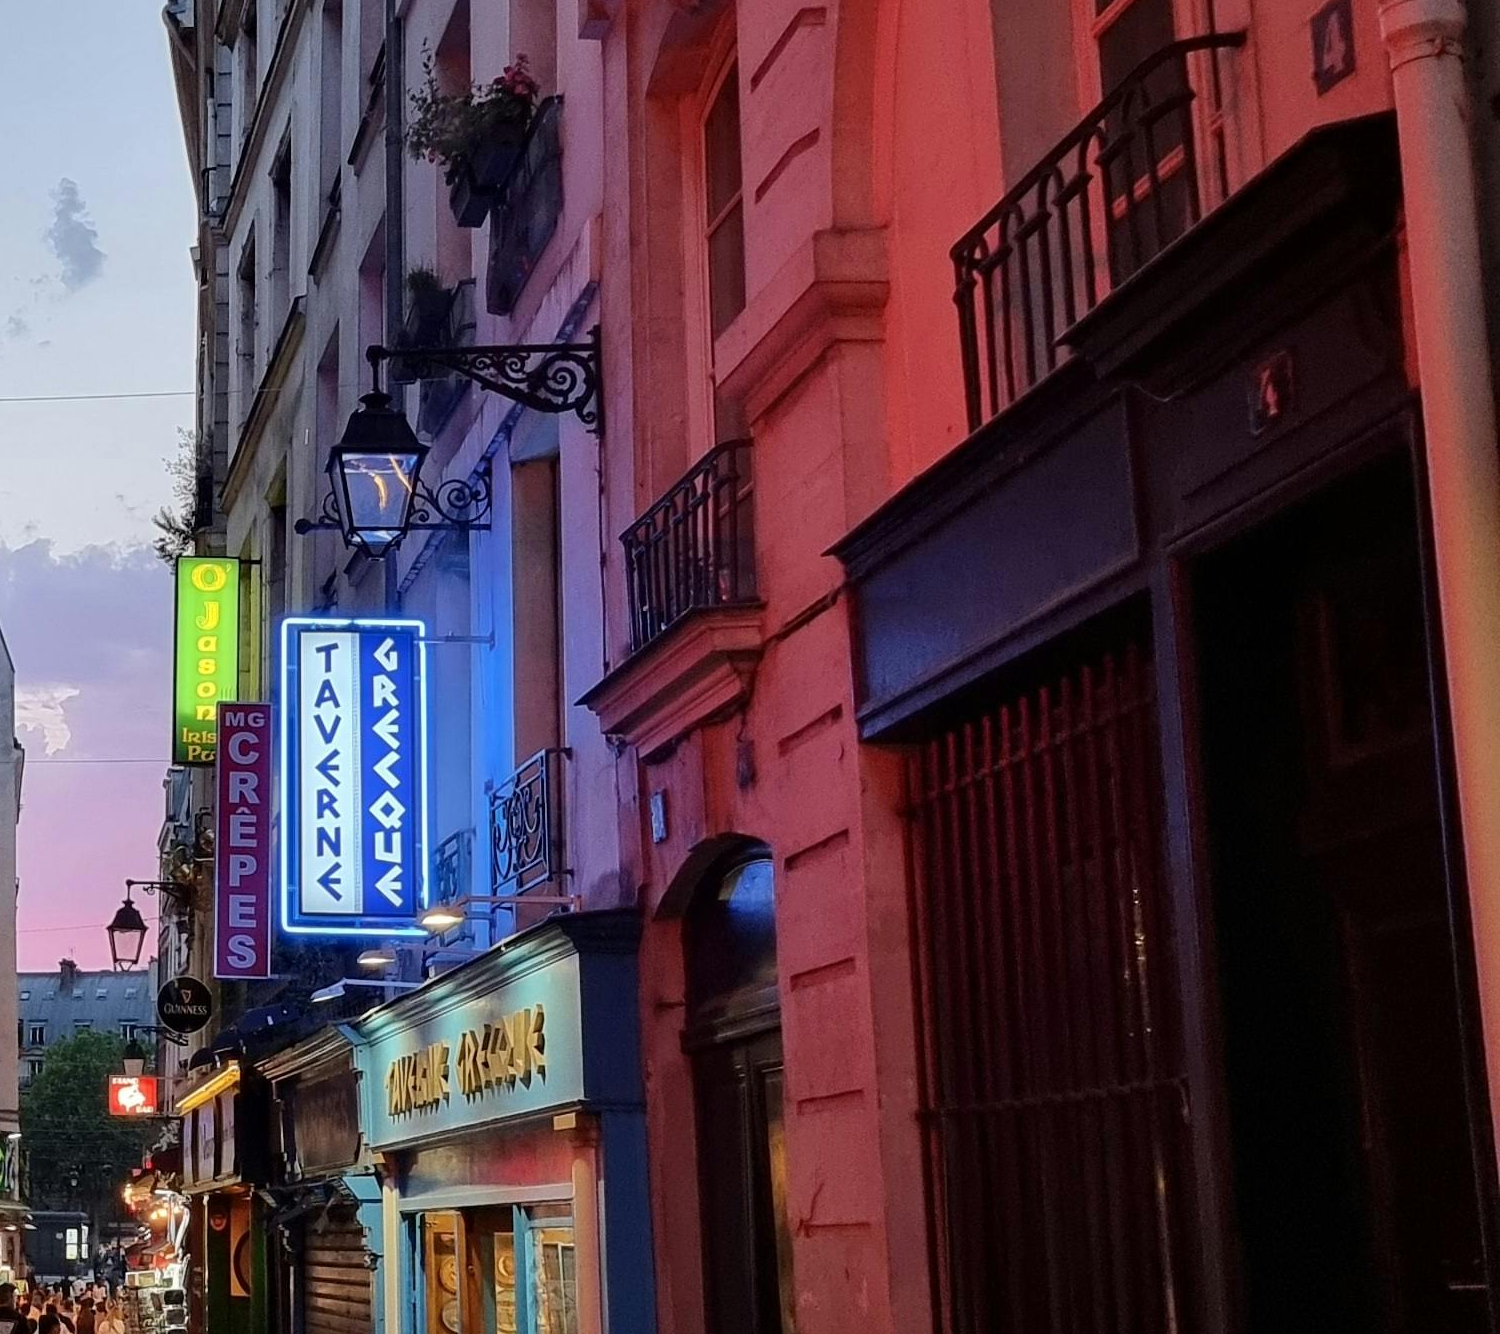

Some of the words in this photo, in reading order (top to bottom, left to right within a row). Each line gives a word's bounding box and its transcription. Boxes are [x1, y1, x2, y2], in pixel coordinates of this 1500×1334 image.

[1322, 10, 1347, 75] 4
[225, 711, 266, 728] MG
[187, 745, 216, 762] Pu
[313, 642, 343, 902] TAVERNE
[368, 637, 407, 908] GRECQUE
[227, 731, 260, 969] CRÊPES
[163, 1002, 208, 1015] GUINNESS
